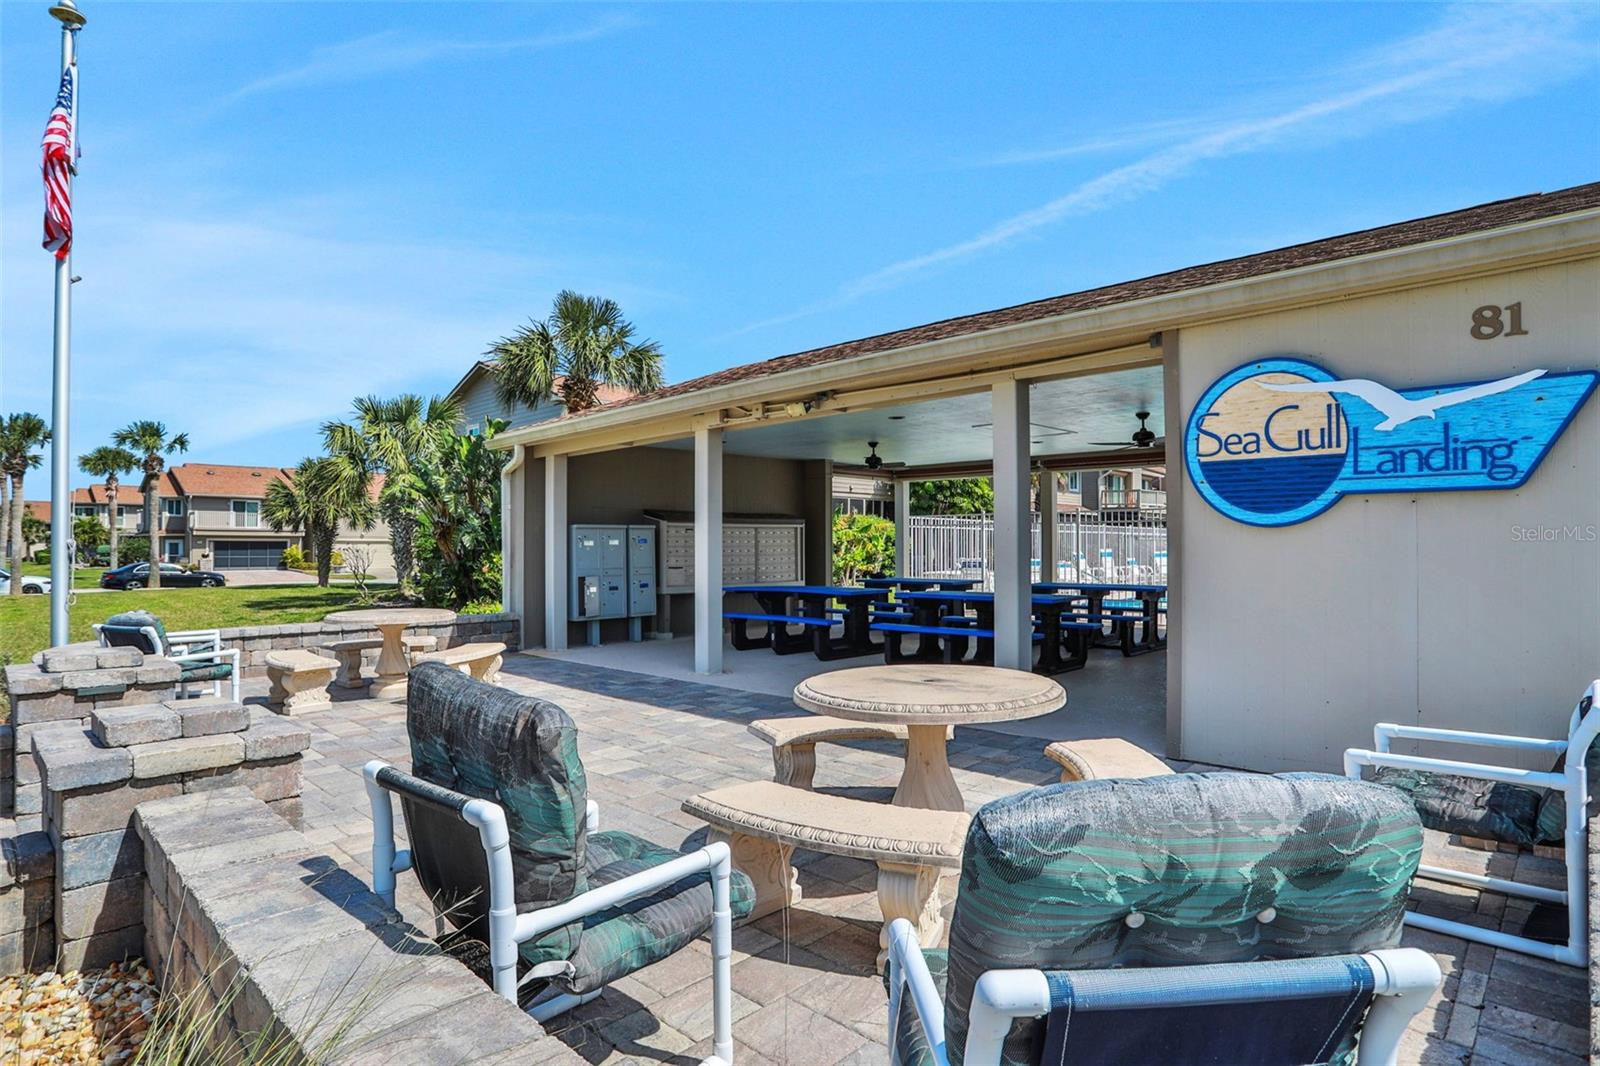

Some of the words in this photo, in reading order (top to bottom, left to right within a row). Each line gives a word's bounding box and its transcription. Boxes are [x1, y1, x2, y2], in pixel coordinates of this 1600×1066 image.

[1470, 301, 1529, 340] 81
[1195, 411, 1261, 457] Sea
[1264, 403, 1342, 452] Gull
[1353, 422, 1517, 481] Landing
